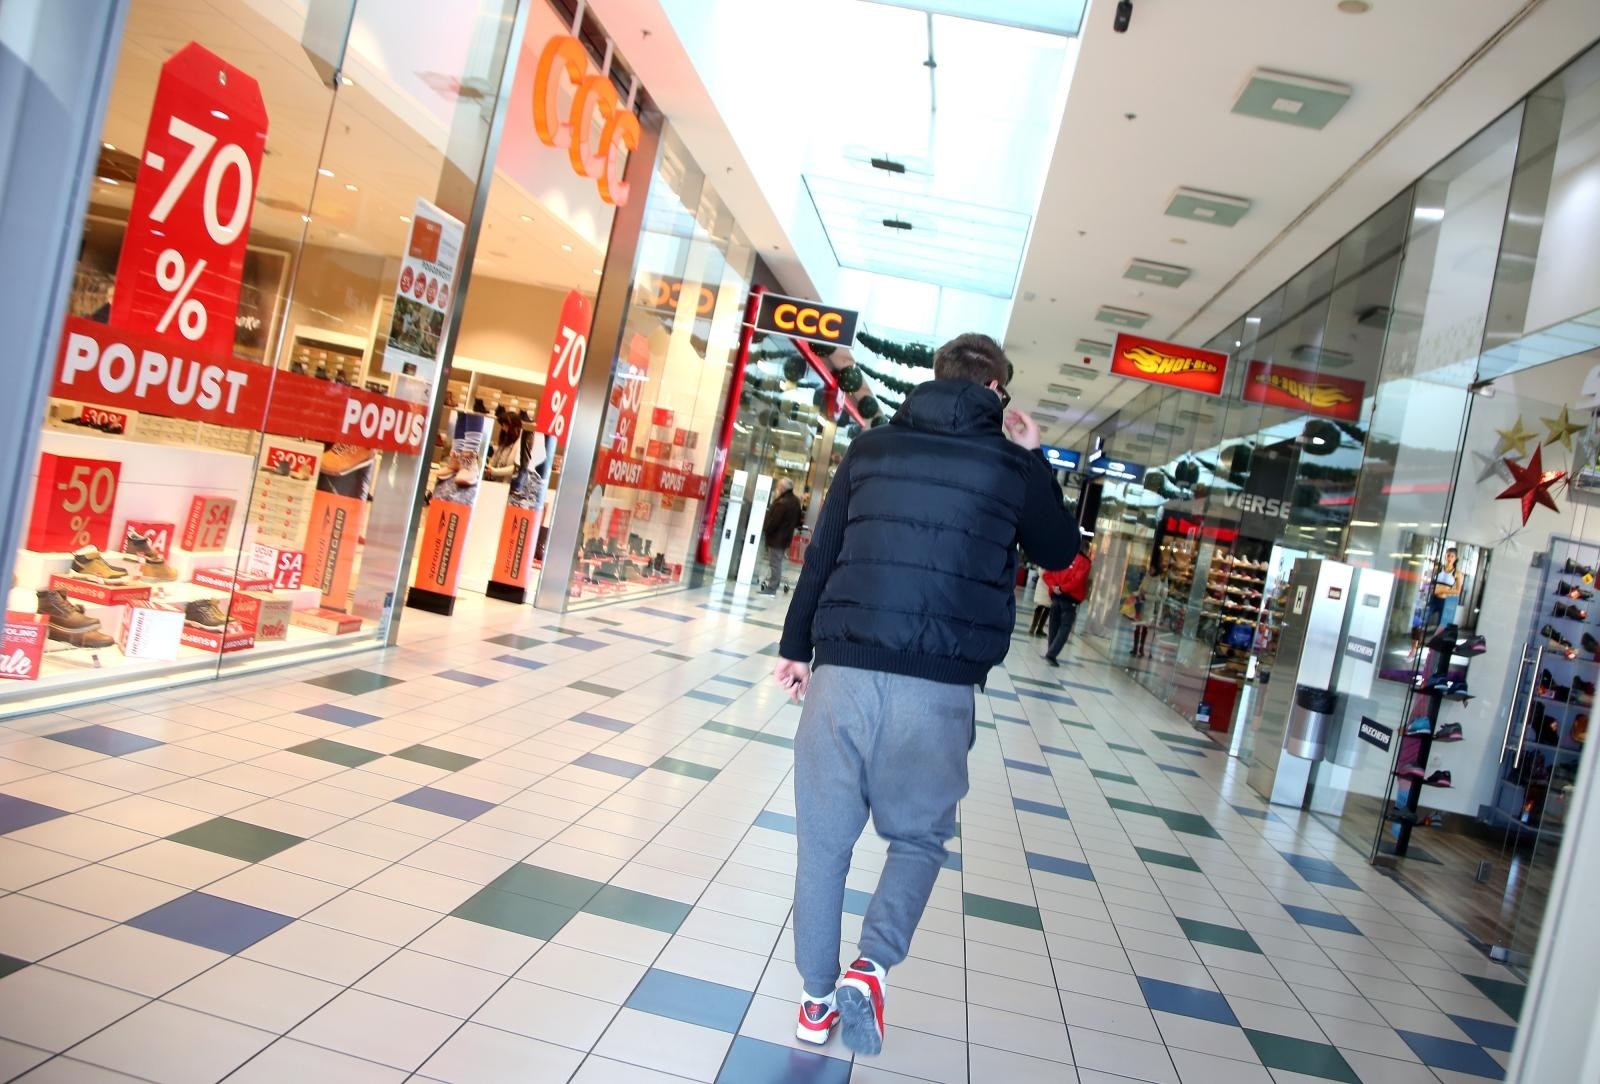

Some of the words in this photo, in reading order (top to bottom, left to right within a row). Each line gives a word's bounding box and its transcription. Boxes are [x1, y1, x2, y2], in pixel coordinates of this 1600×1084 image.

[533, 35, 641, 206] CCC
[144, 116, 253, 246] -70
[155, 249, 207, 341] %
[774, 303, 843, 339] CCC
[60, 332, 249, 414] POPUST
[552, 326, 586, 387] -70
[341, 398, 428, 446] POPUS
[548, 390, 567, 436] %
[608, 458, 642, 484] POPUST
[660, 470, 686, 493] POPUST
[58, 465, 115, 514] -50
[1223, 490, 1293, 520] VERSE
[70, 515, 91, 546] %
[206, 504, 230, 526] SA
[200, 526, 226, 548] LE
[279, 552, 304, 571] SA
[275, 571, 302, 589] LE
[1361, 723, 1391, 745] SKECHERS
